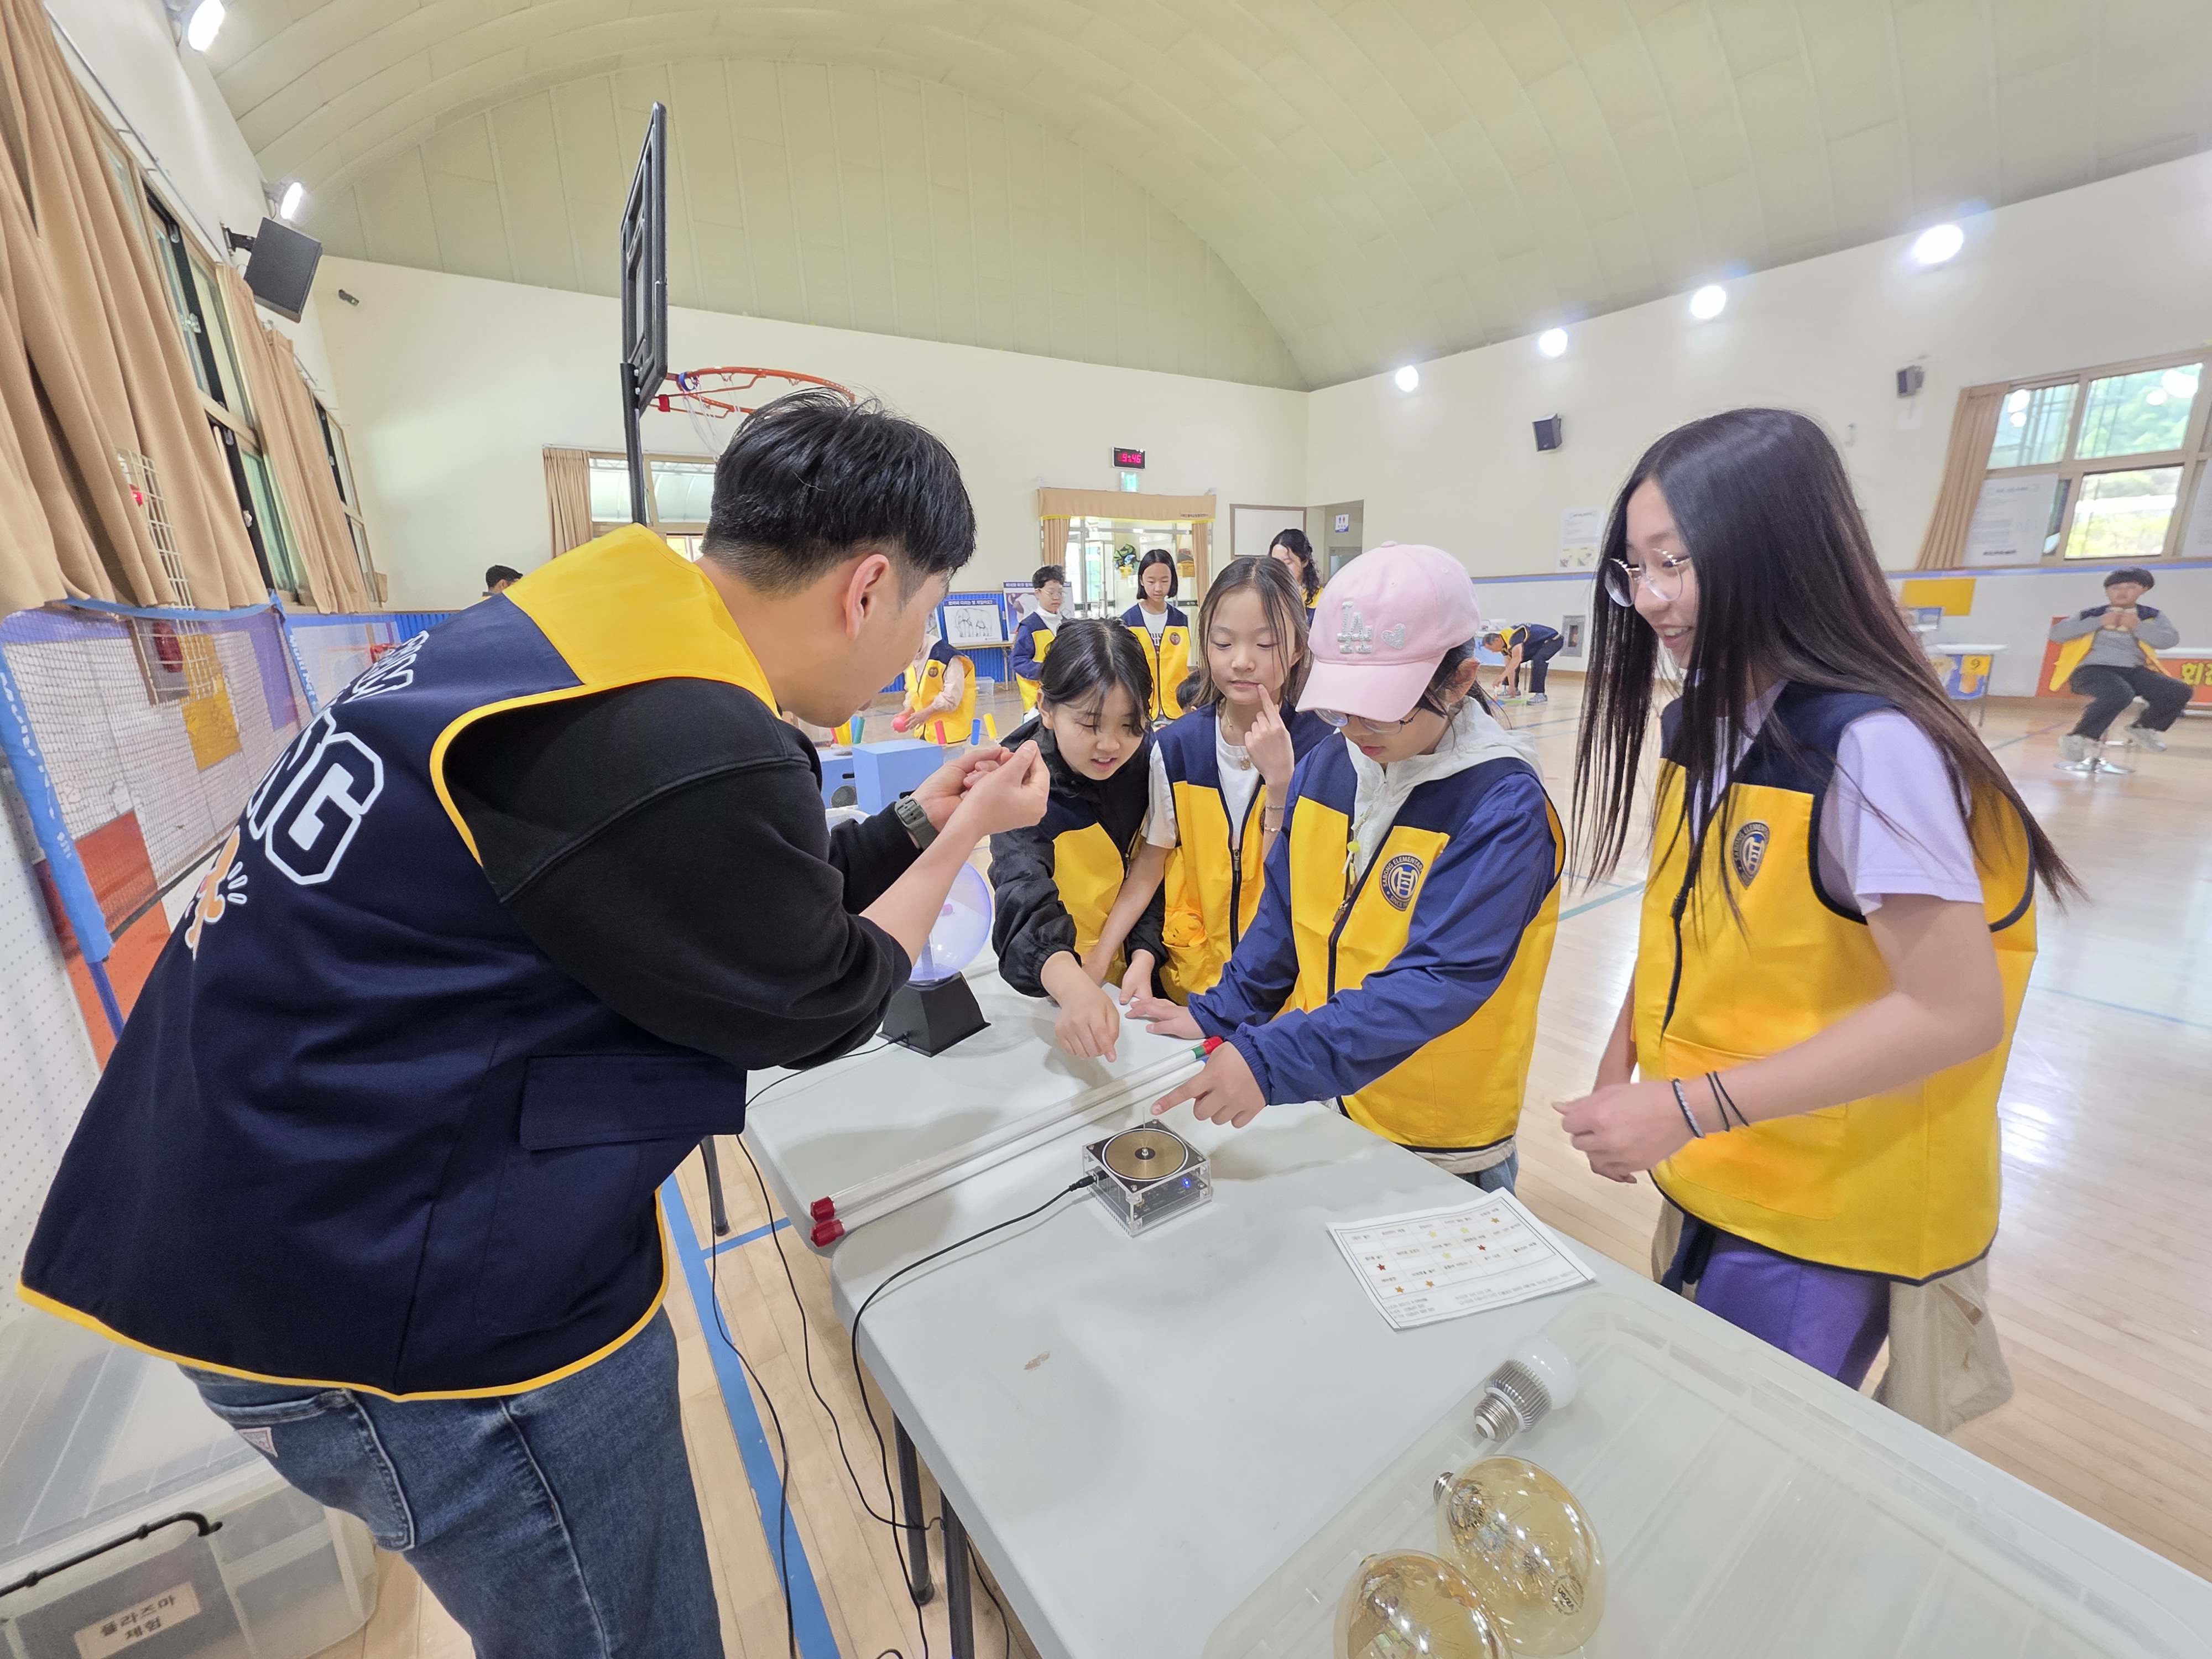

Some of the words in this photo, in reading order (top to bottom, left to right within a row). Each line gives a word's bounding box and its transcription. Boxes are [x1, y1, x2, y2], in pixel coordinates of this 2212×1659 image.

[1337, 601, 1373, 654] LA
[1383, 863, 1394, 888] SABONG
[1389, 895, 1402, 907] SINCE
[100, 1594, 176, 1637] 플라즈마
[124, 1616, 162, 1640] 체험
